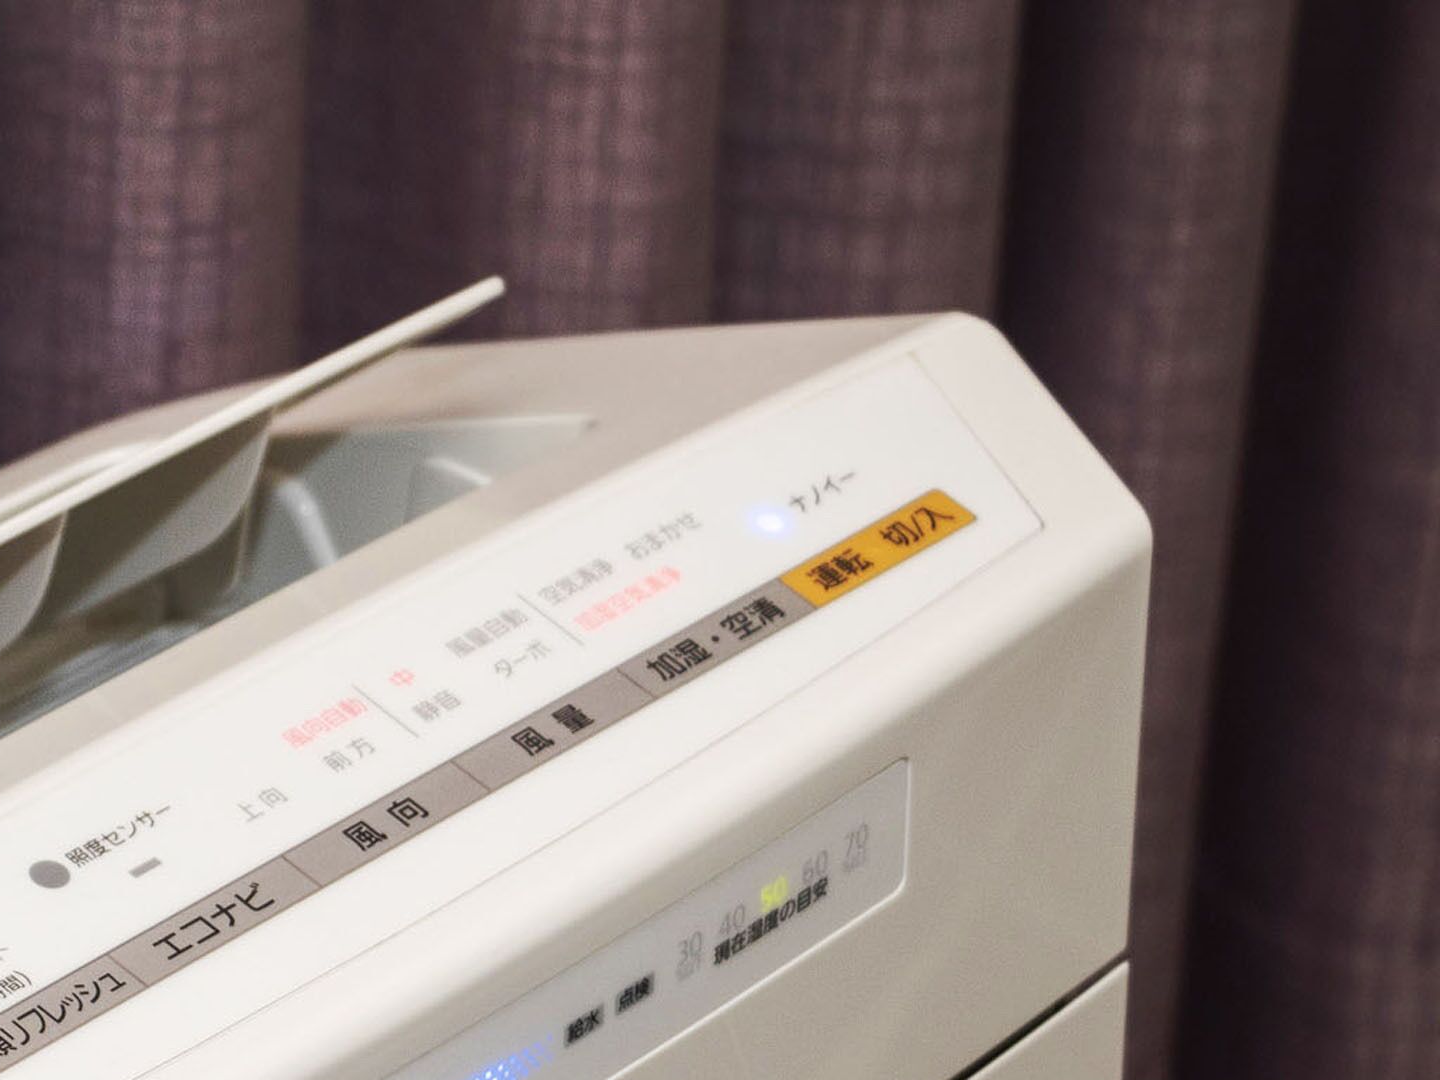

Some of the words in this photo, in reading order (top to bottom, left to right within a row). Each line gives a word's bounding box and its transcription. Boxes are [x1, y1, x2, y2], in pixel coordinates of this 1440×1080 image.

[789, 470, 856, 512] ナノイー
[807, 549, 874, 591] 運転
[879, 506, 955, 548] 切/入
[647, 596, 786, 682] 加湿・空清
[65, 804, 172, 868] 照度センサー
[238, 787, 288, 822] 上向
[153, 883, 276, 961] エコナビ
